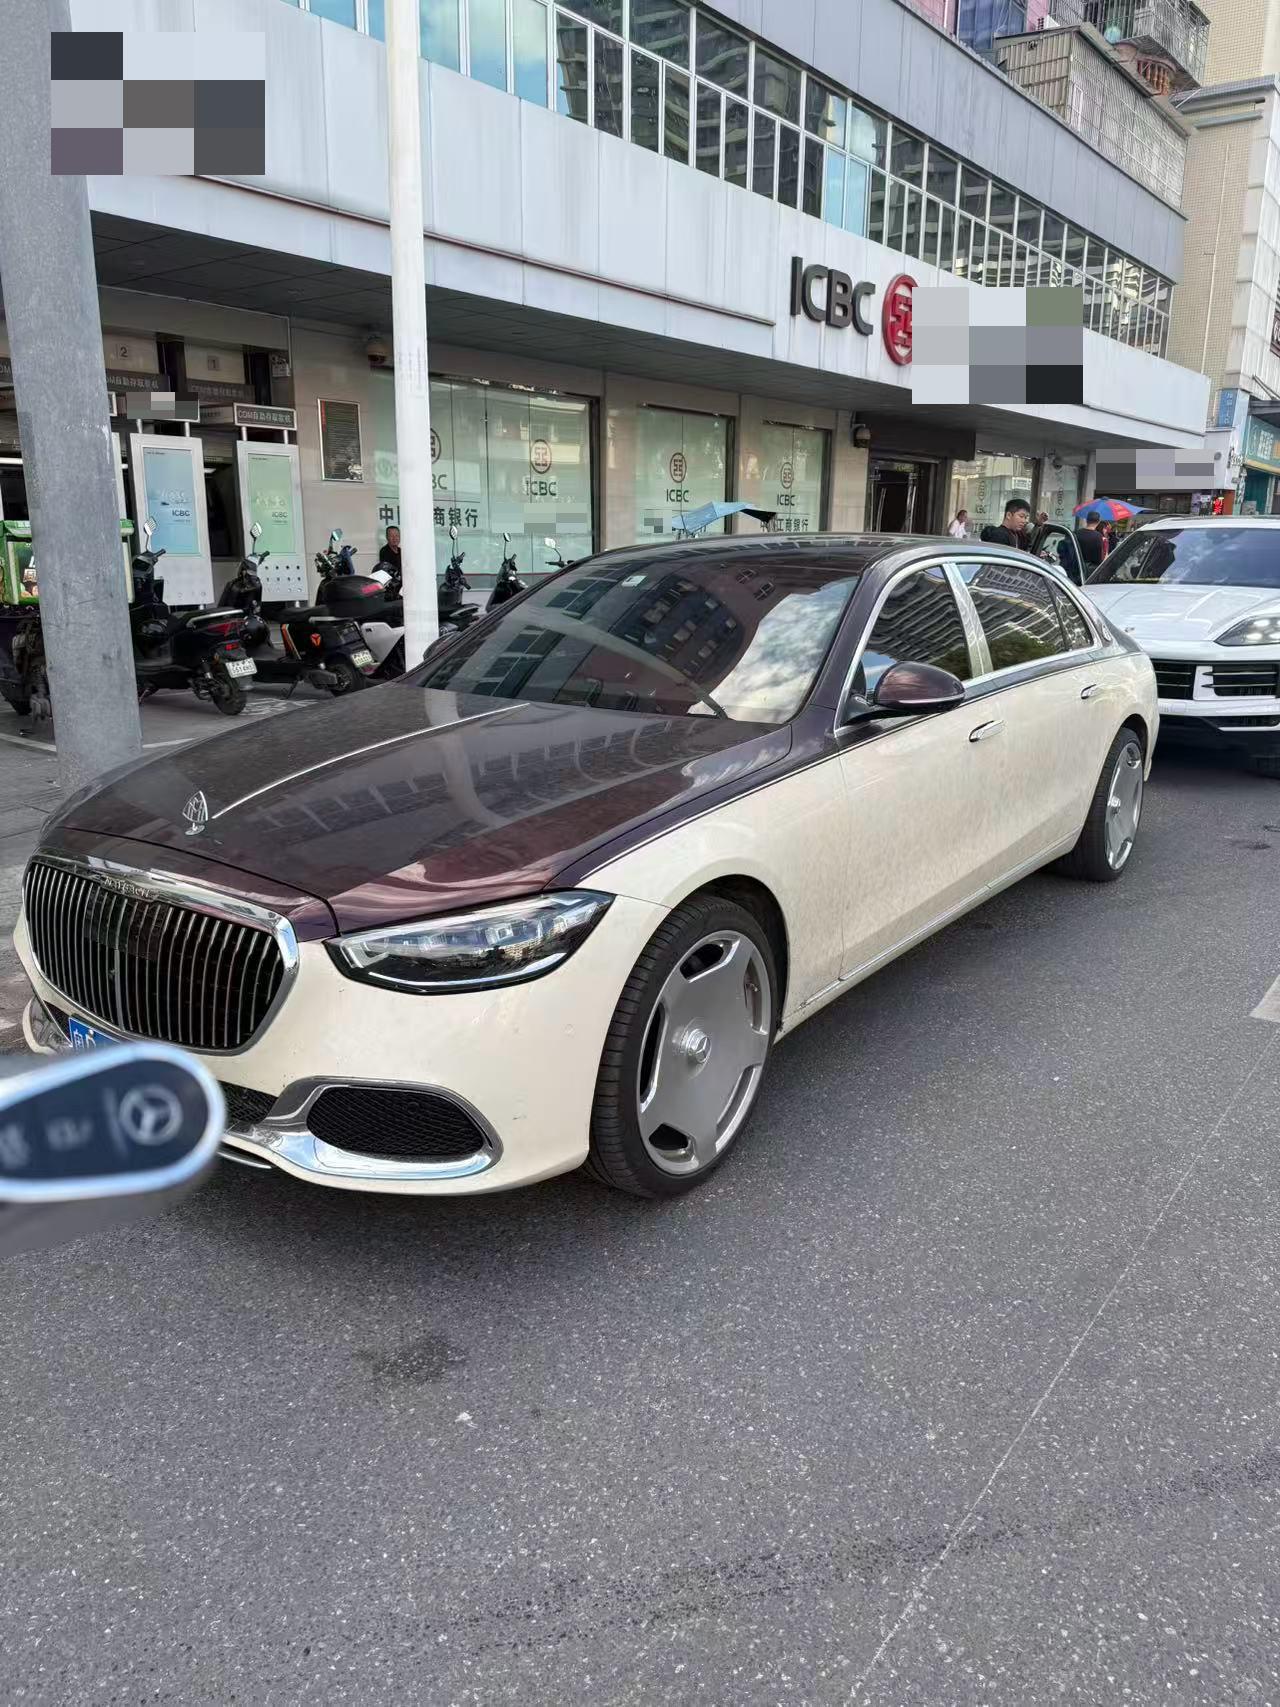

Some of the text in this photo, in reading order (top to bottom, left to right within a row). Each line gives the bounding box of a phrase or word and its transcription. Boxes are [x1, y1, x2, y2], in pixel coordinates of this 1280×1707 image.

[790, 256, 876, 336] ICBC
[120, 346, 129, 358] 2
[526, 481, 557, 496] ICBC
[666, 489, 689, 503] ICBC
[777, 494, 795, 506] ICBC
[172, 509, 190, 517] ICBC
[379, 504, 478, 528] 中商银行
